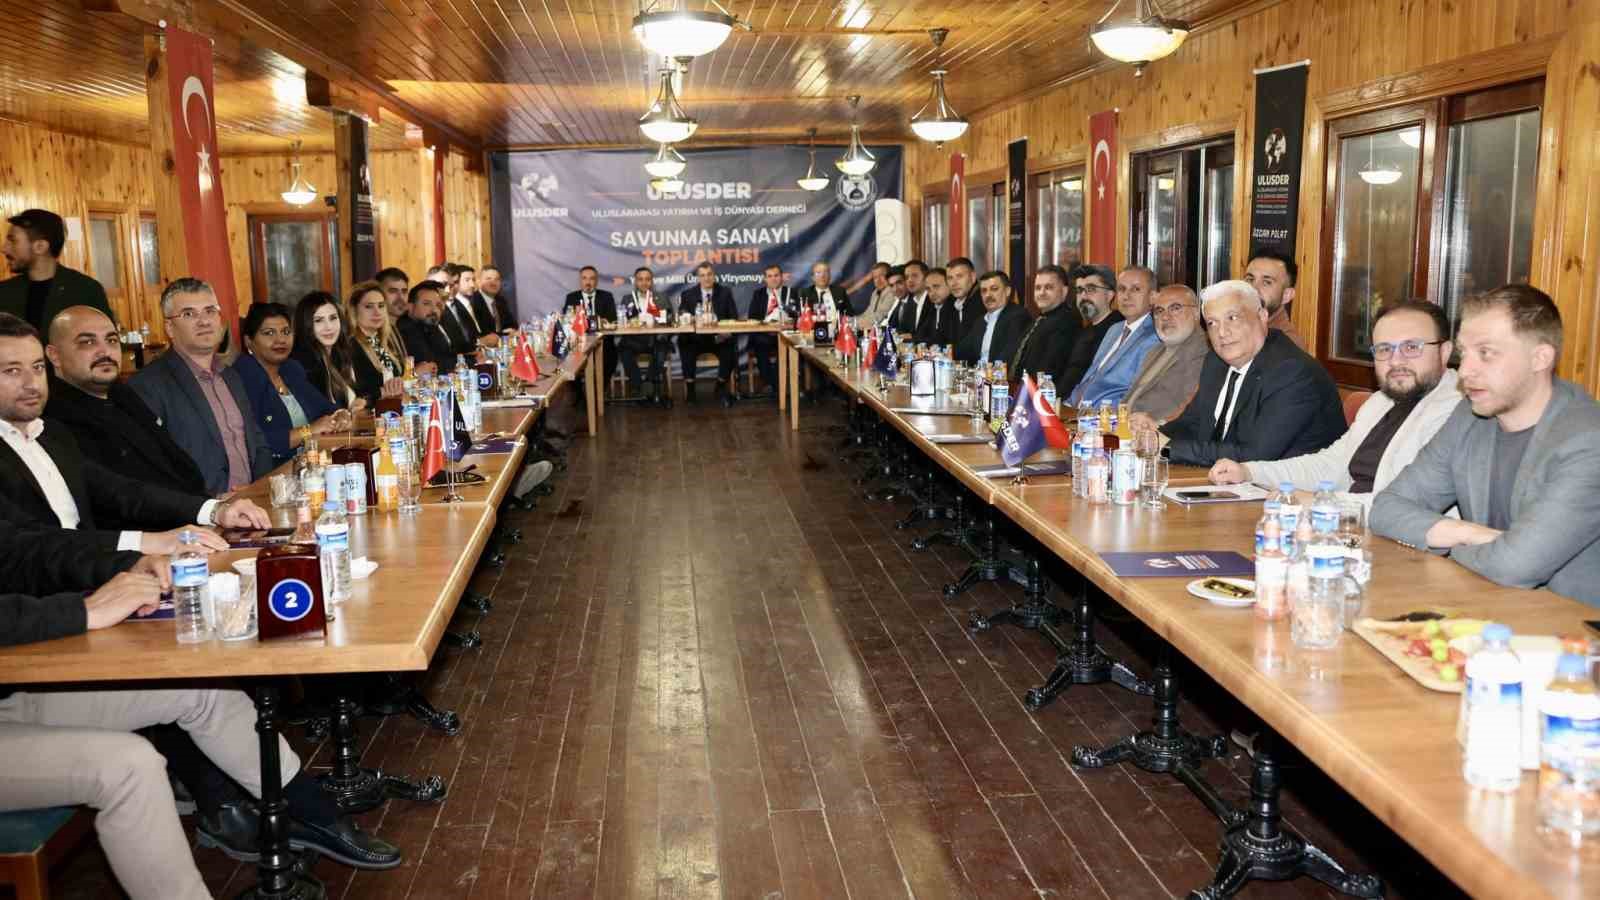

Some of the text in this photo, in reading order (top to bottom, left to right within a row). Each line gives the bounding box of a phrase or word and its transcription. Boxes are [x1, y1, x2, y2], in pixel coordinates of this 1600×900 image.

[1257, 175, 1290, 185] ULUSDER
[512, 208, 569, 218] ULUSDER
[591, 208, 661, 218] ULUSLARARASI
[662, 207, 699, 217] YATIRIM
[700, 207, 713, 216] VE
[724, 204, 764, 216] DÜNYASI
[610, 223, 790, 248] SAVUNMA SANAYİ
[641, 248, 761, 266] TOPLANTISI
[720, 272, 765, 285] Vizyonuy
[284, 591, 299, 609] 2
